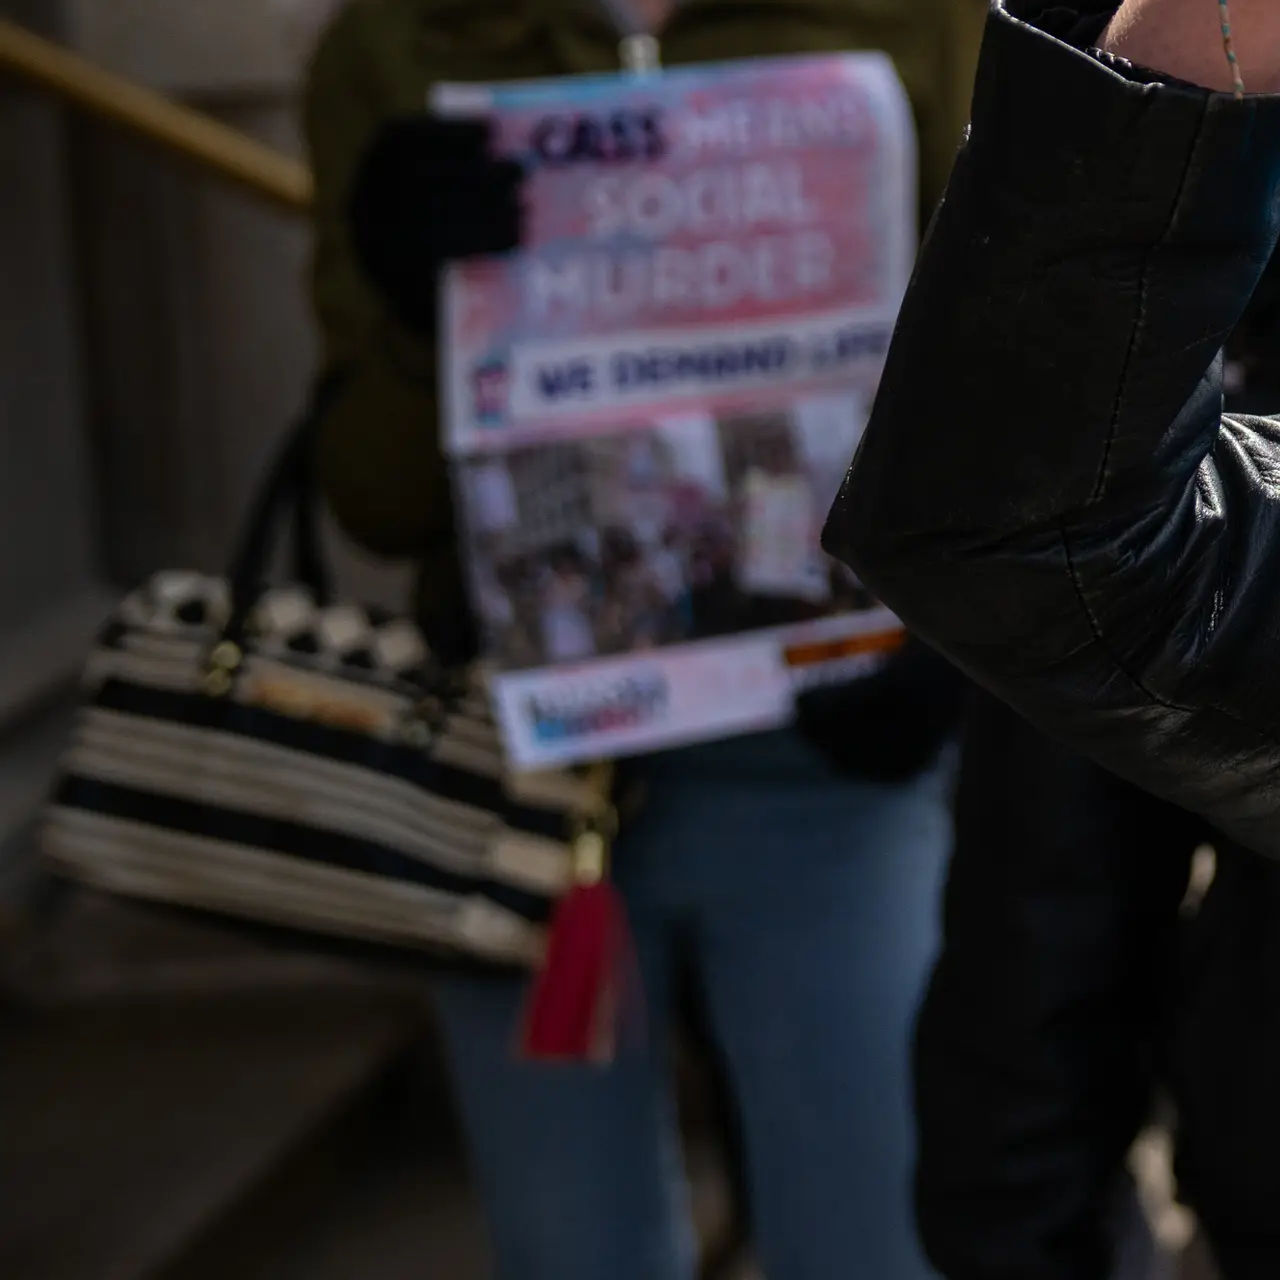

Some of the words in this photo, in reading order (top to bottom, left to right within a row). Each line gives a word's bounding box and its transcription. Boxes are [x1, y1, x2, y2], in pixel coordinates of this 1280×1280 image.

[529, 106, 668, 164] CASS
[580, 158, 814, 234] SOCIAL
[522, 228, 838, 320] MURDER
